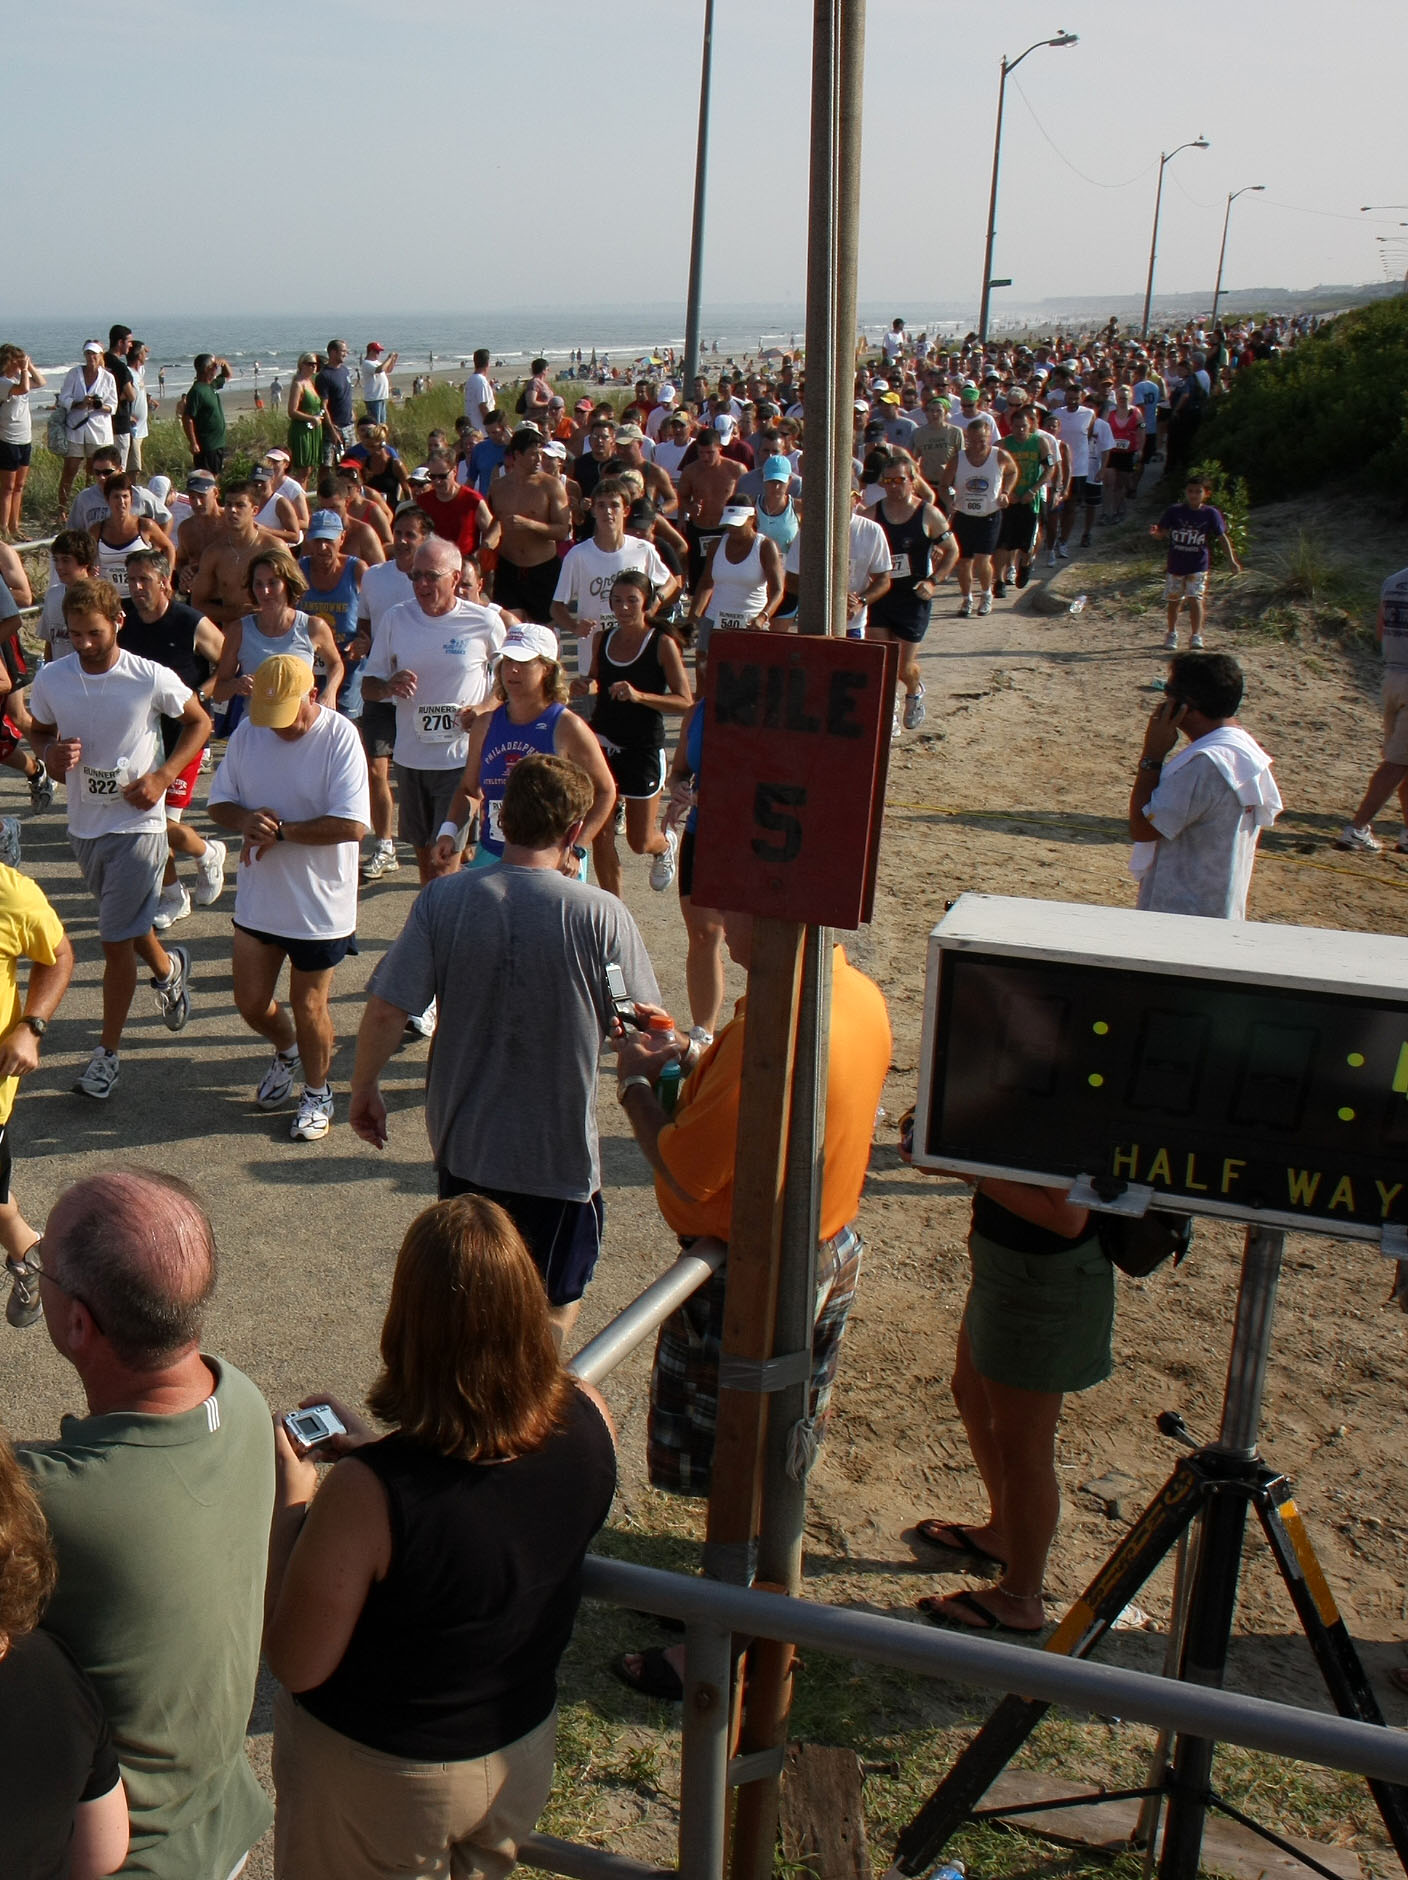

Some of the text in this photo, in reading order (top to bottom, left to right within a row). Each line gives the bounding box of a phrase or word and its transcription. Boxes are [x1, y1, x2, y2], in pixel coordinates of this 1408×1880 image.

[721, 618, 740, 629] 540
[418, 705, 457, 714] RUNNERS
[714, 659, 870, 740] MILE
[422, 714, 452, 732] 270
[484, 741, 540, 765] PHILADELPH
[88, 778, 119, 795] 322
[750, 781, 808, 864] 5
[1111, 1143, 1403, 1218] HALF WAY
